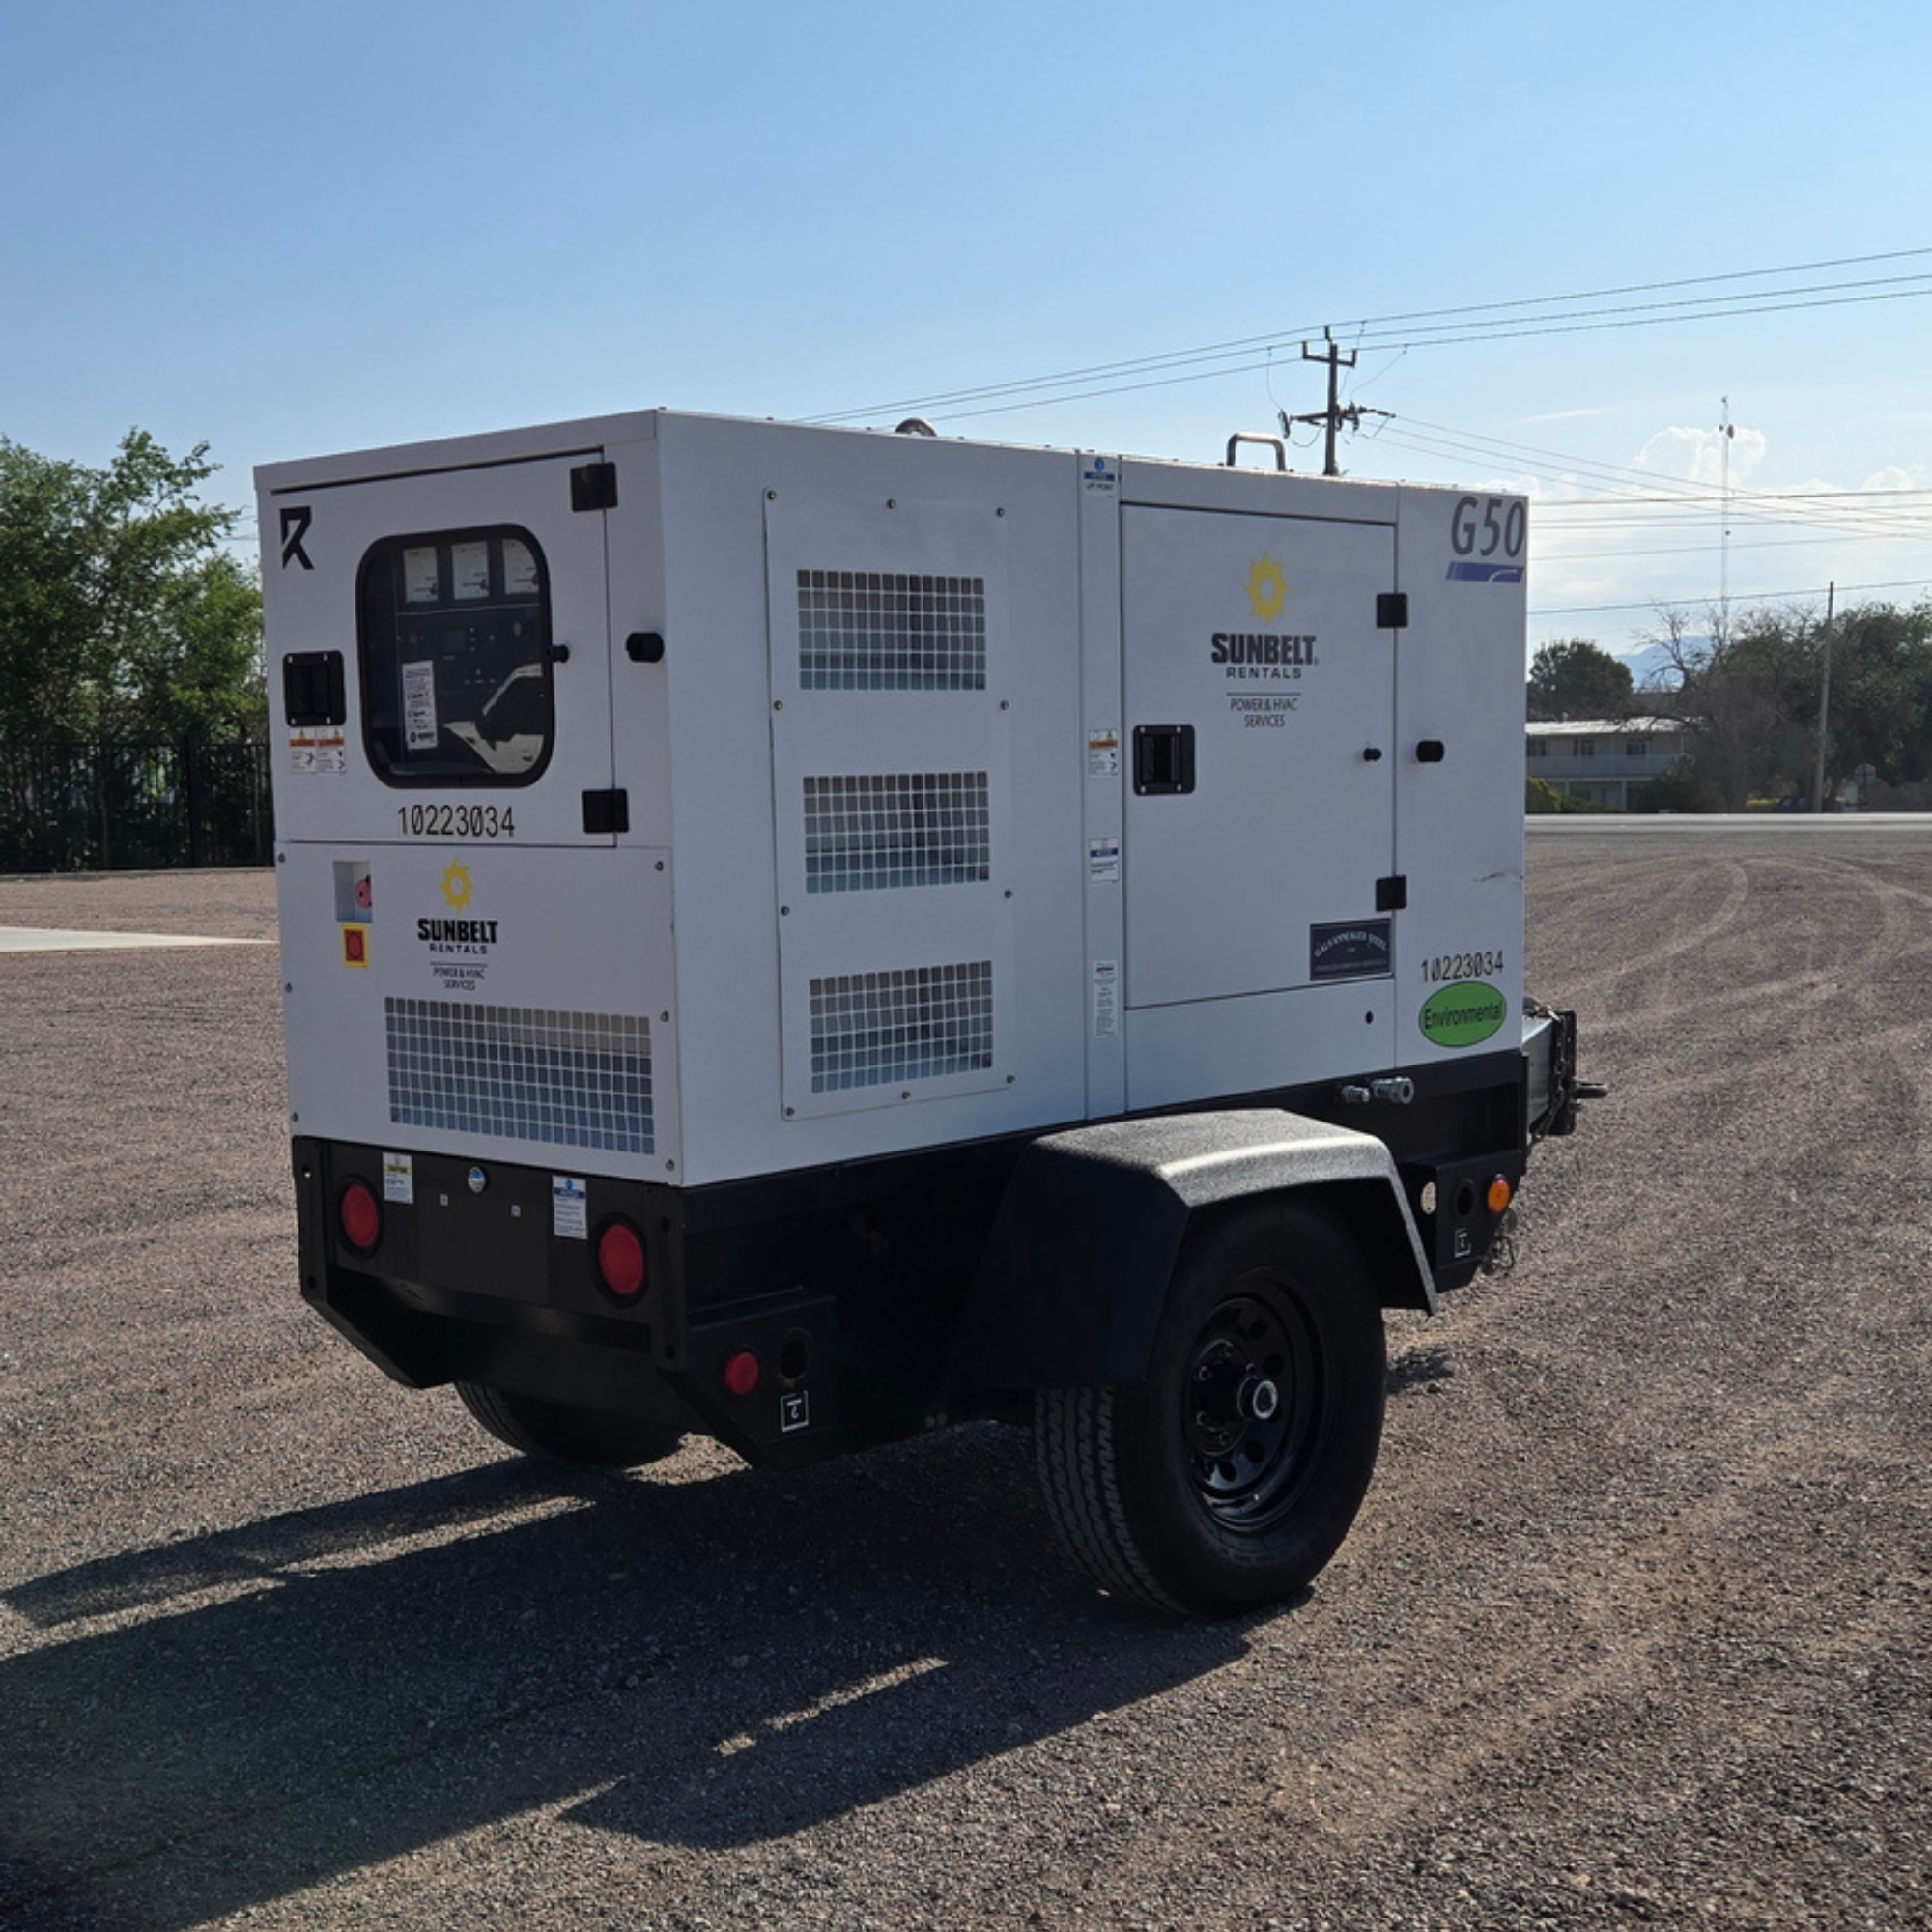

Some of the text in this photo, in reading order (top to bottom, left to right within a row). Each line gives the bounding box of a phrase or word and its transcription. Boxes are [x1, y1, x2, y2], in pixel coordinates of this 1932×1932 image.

[1451, 496, 1526, 558] G50
[1211, 632, 1317, 665] SUNBELT
[1225, 667, 1302, 679] RENTALS
[1230, 697, 1298, 711] POWER & HVAC
[1244, 714, 1286, 728] SERVICES
[398, 804, 515, 838] 10223034
[417, 918, 498, 944] SUNBELT
[429, 943, 488, 954] RENTALS
[1422, 950, 1504, 983] 10223034
[443, 979, 475, 991] SERVICES
[1425, 1000, 1503, 1030] Environmental
